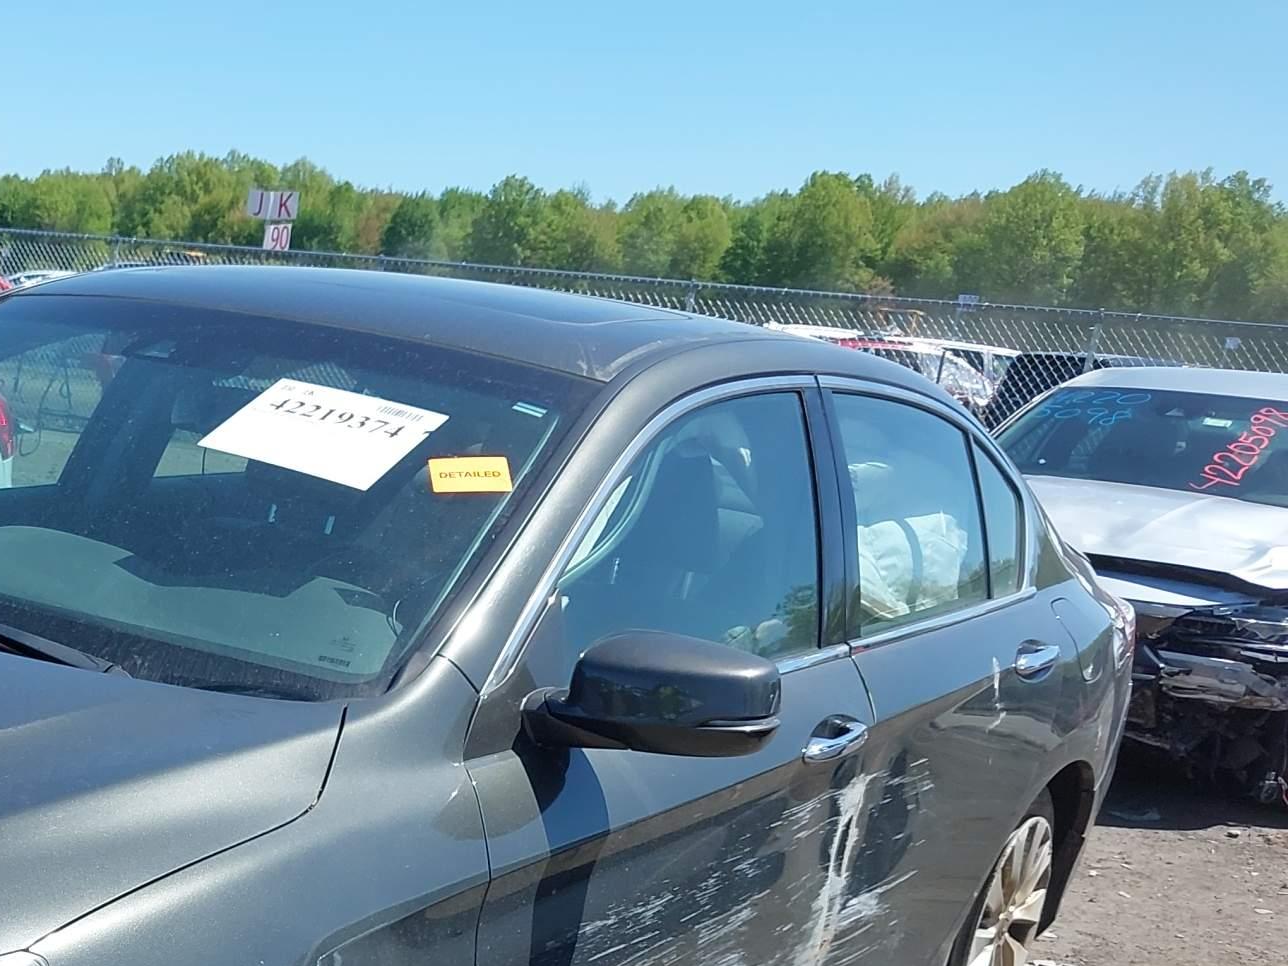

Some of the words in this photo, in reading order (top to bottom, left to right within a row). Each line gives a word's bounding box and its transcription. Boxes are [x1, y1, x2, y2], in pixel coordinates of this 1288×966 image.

[277, 192, 293, 218] K
[271, 225, 289, 250] 90
[270, 399, 406, 439] 42219374
[439, 470, 502, 479] DETAILED
